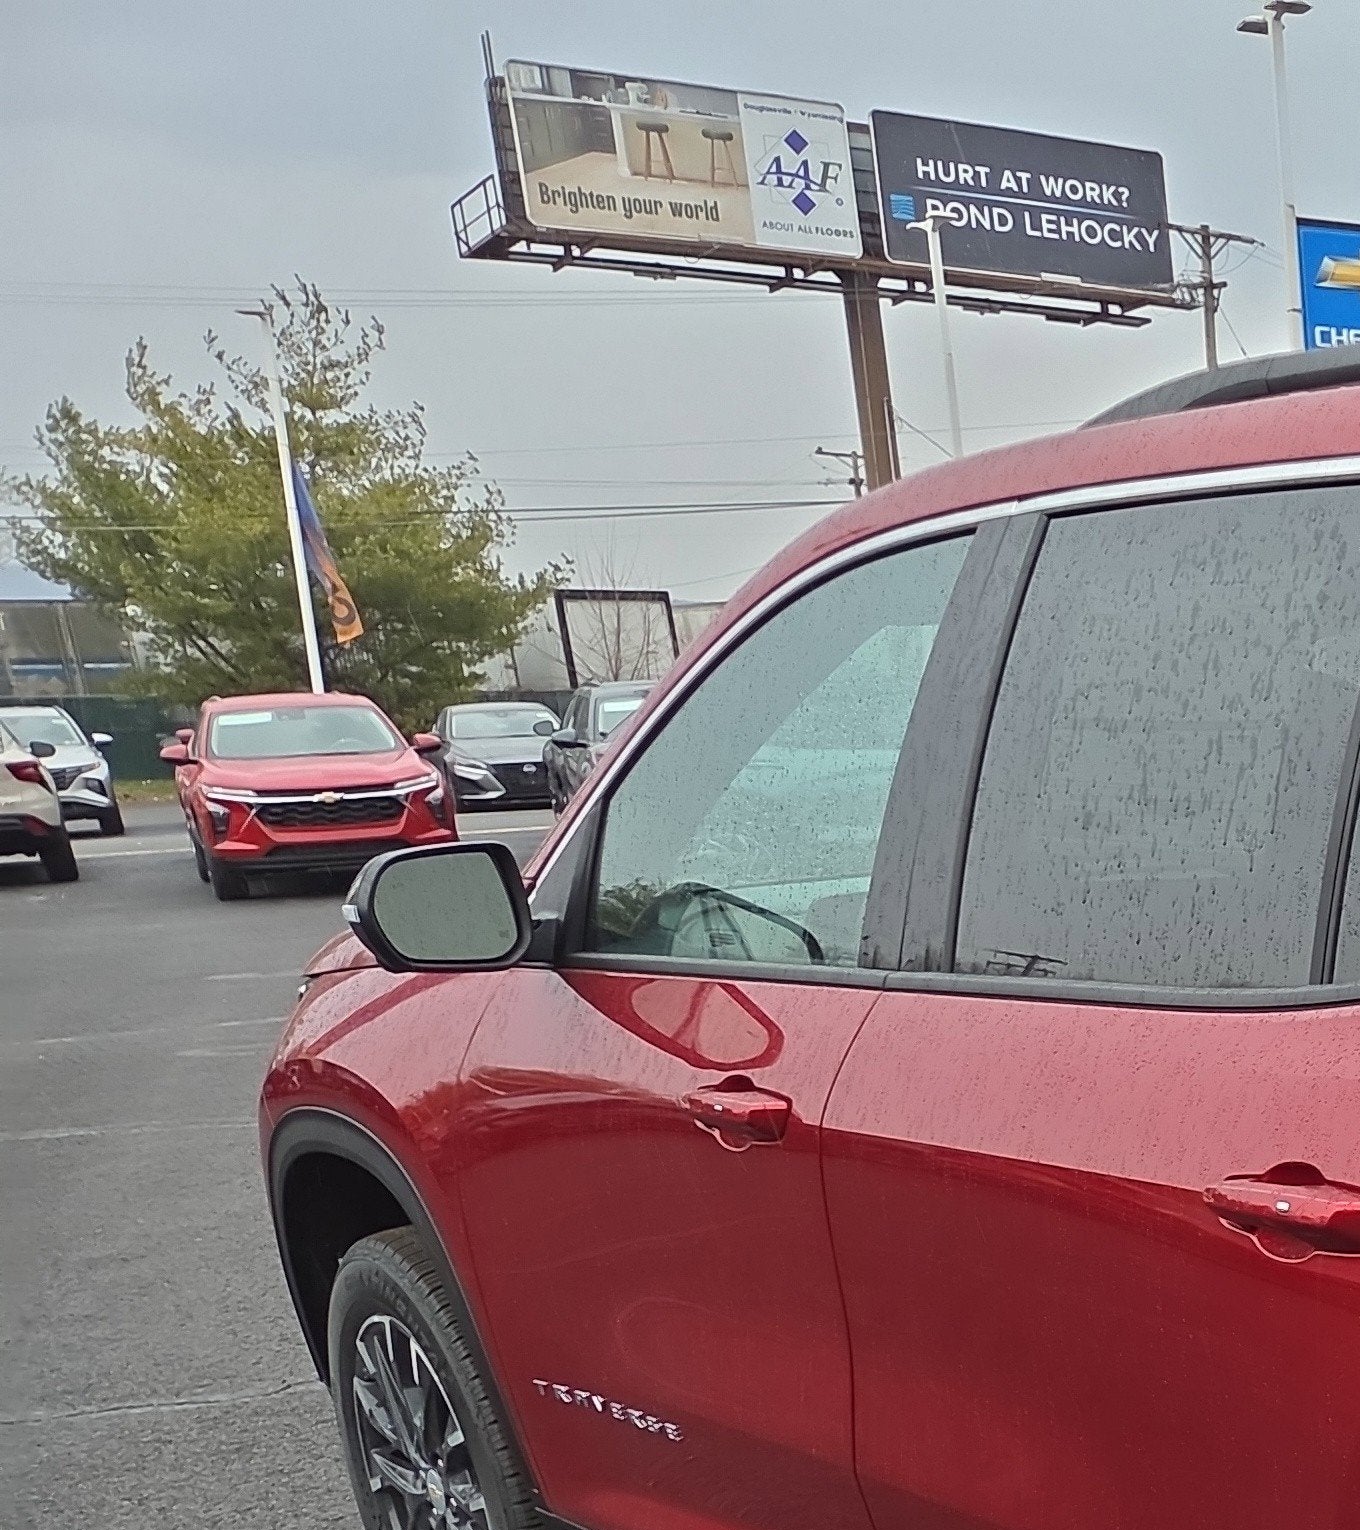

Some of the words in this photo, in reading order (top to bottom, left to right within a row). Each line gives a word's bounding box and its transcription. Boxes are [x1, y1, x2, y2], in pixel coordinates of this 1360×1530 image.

[756, 155, 843, 194] AAF
[916, 157, 991, 188] HURT
[1000, 169, 1032, 194] AT
[1039, 174, 1131, 208] WORK?
[538, 181, 617, 214] Brighten
[622, 195, 664, 220] your
[668, 199, 721, 222] world
[762, 220, 794, 233] ABOUT
[798, 224, 813, 235] ALL
[815, 227, 855, 239] FLOORS
[925, 198, 1014, 233] POND
[1023, 211, 1160, 253] LEHOCKY
[532, 1379, 685, 1441] TRAVERSE
